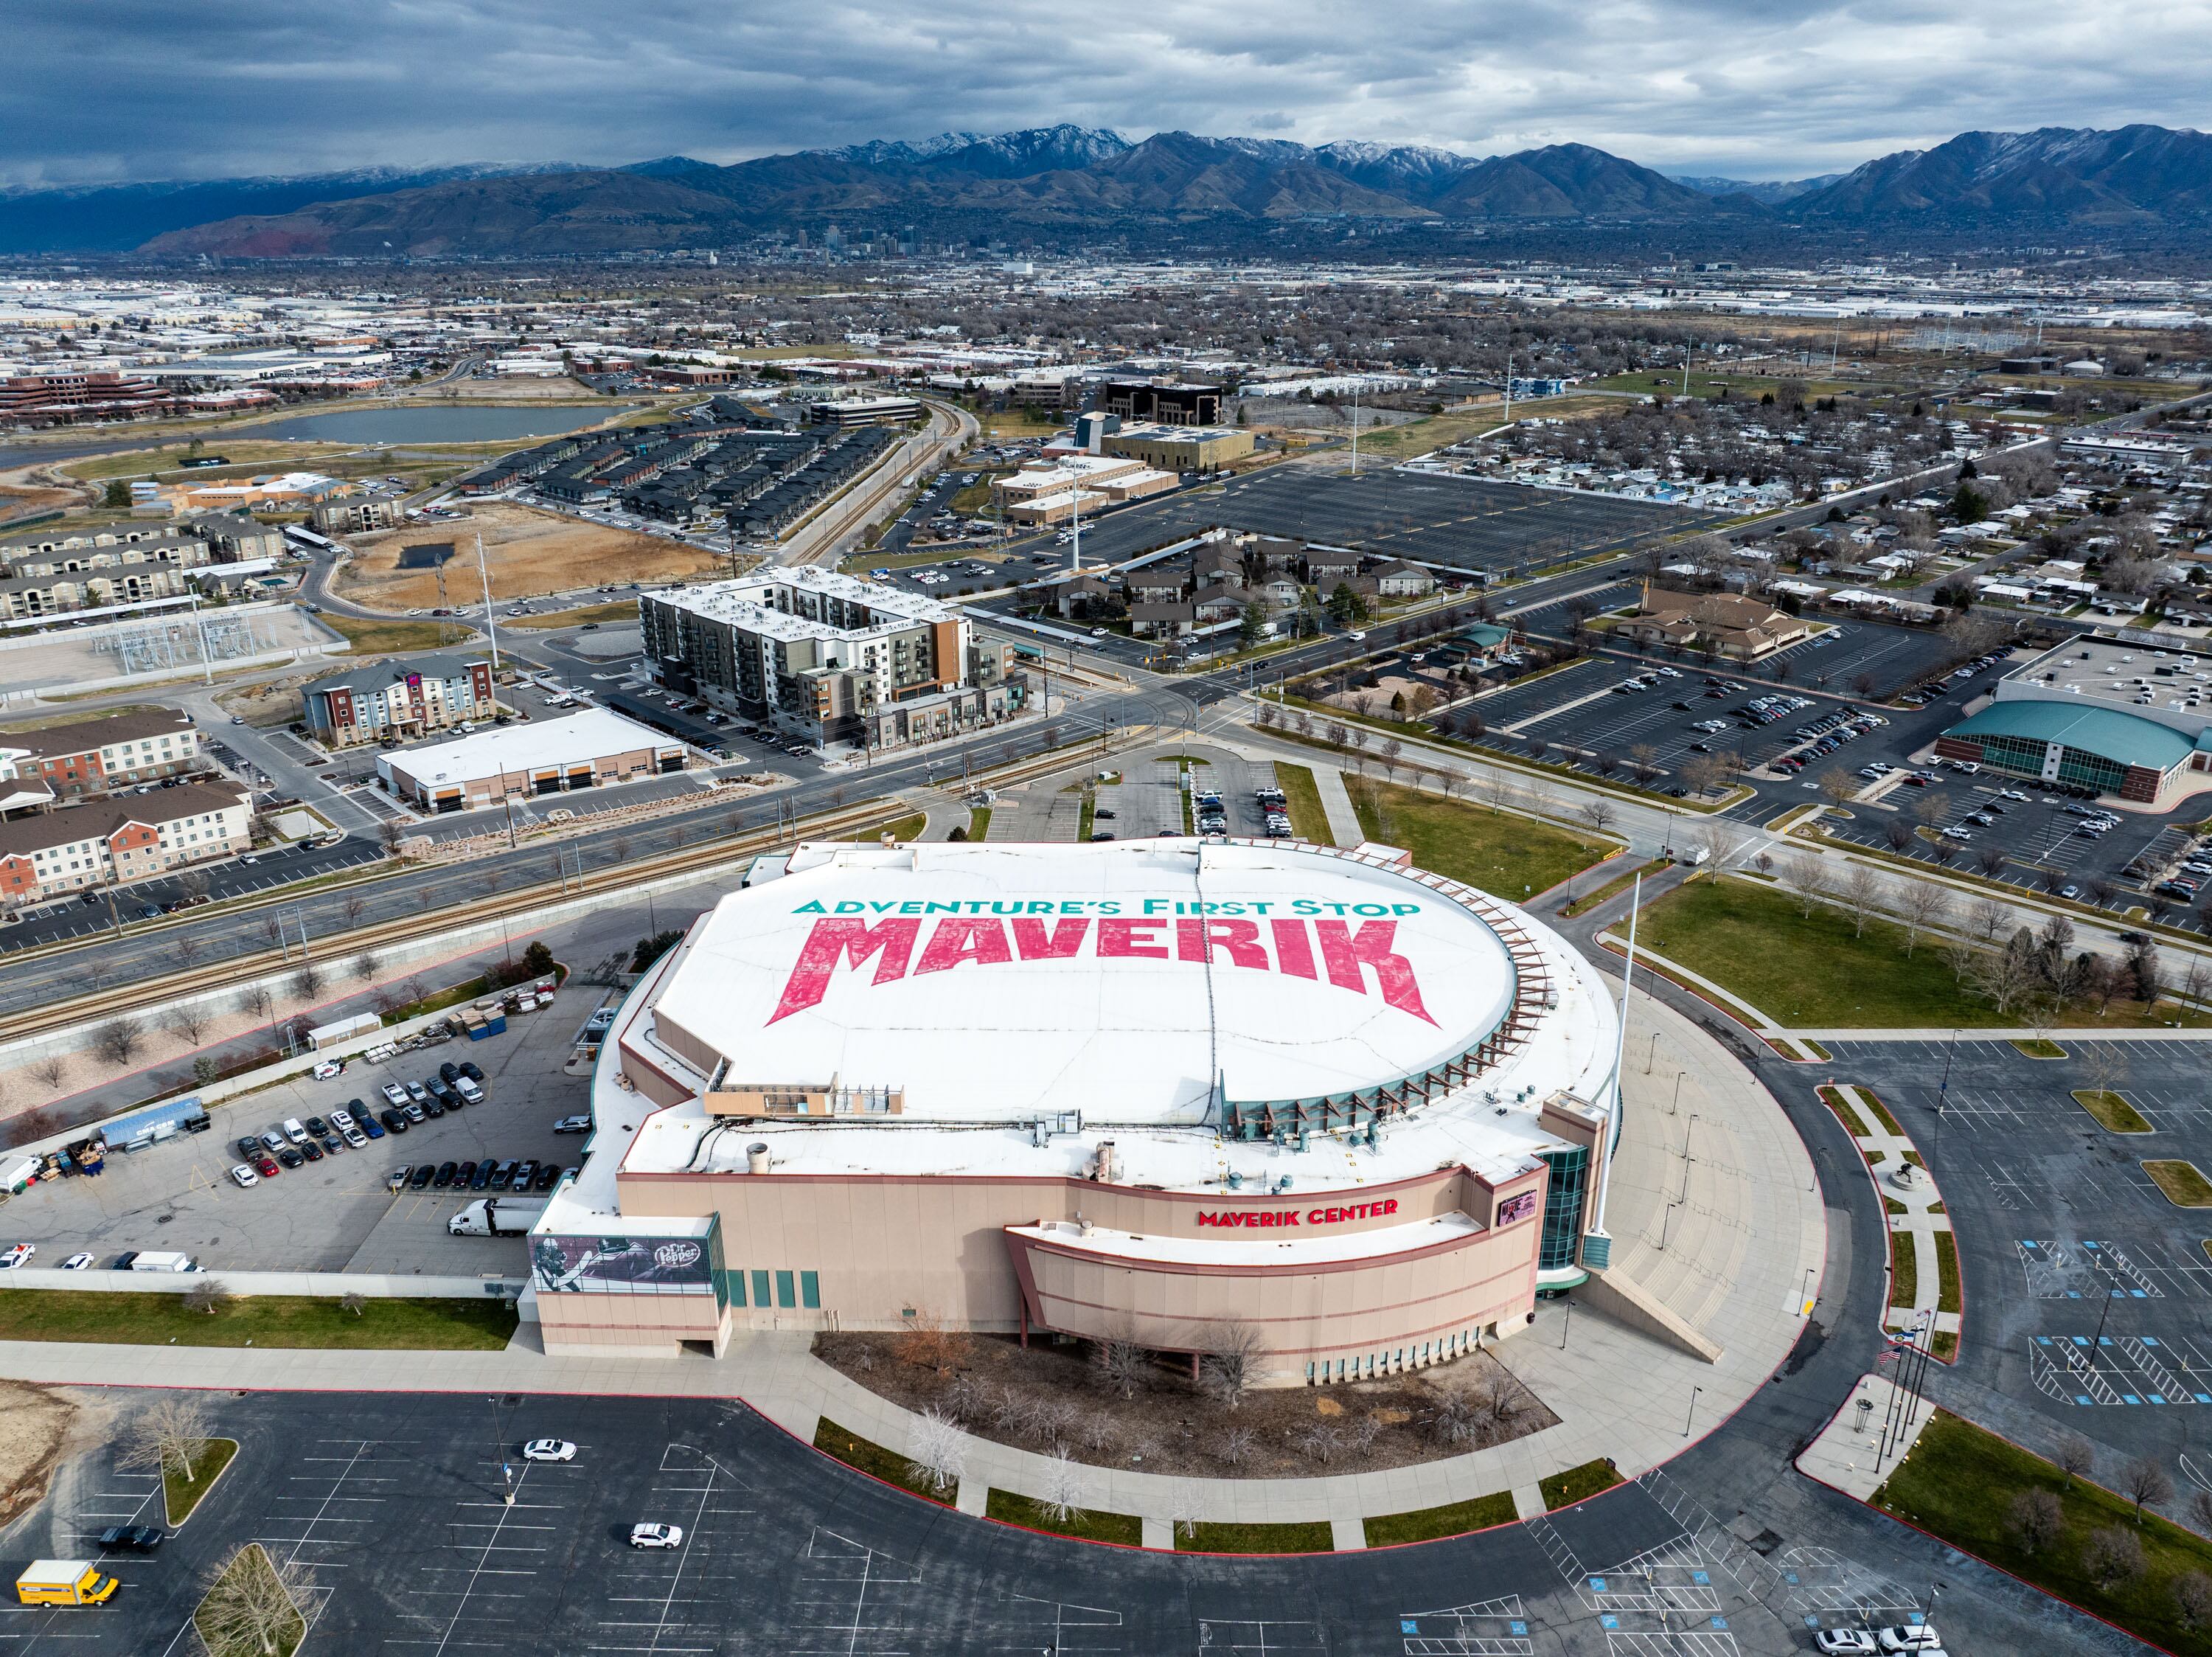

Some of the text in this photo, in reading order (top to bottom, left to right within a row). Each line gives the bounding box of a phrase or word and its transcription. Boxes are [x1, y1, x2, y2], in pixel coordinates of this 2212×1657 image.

[790, 898, 1421, 917] ADVENTURE'S FIRST STOP
[765, 917, 1440, 1028] MAVERIK
[136, 1126, 155, 1136] CMA
[1199, 1199, 1398, 1228] MAVERIK CENTER
[659, 1246, 697, 1264] Pepper
[669, 1243, 686, 1252] Dr
